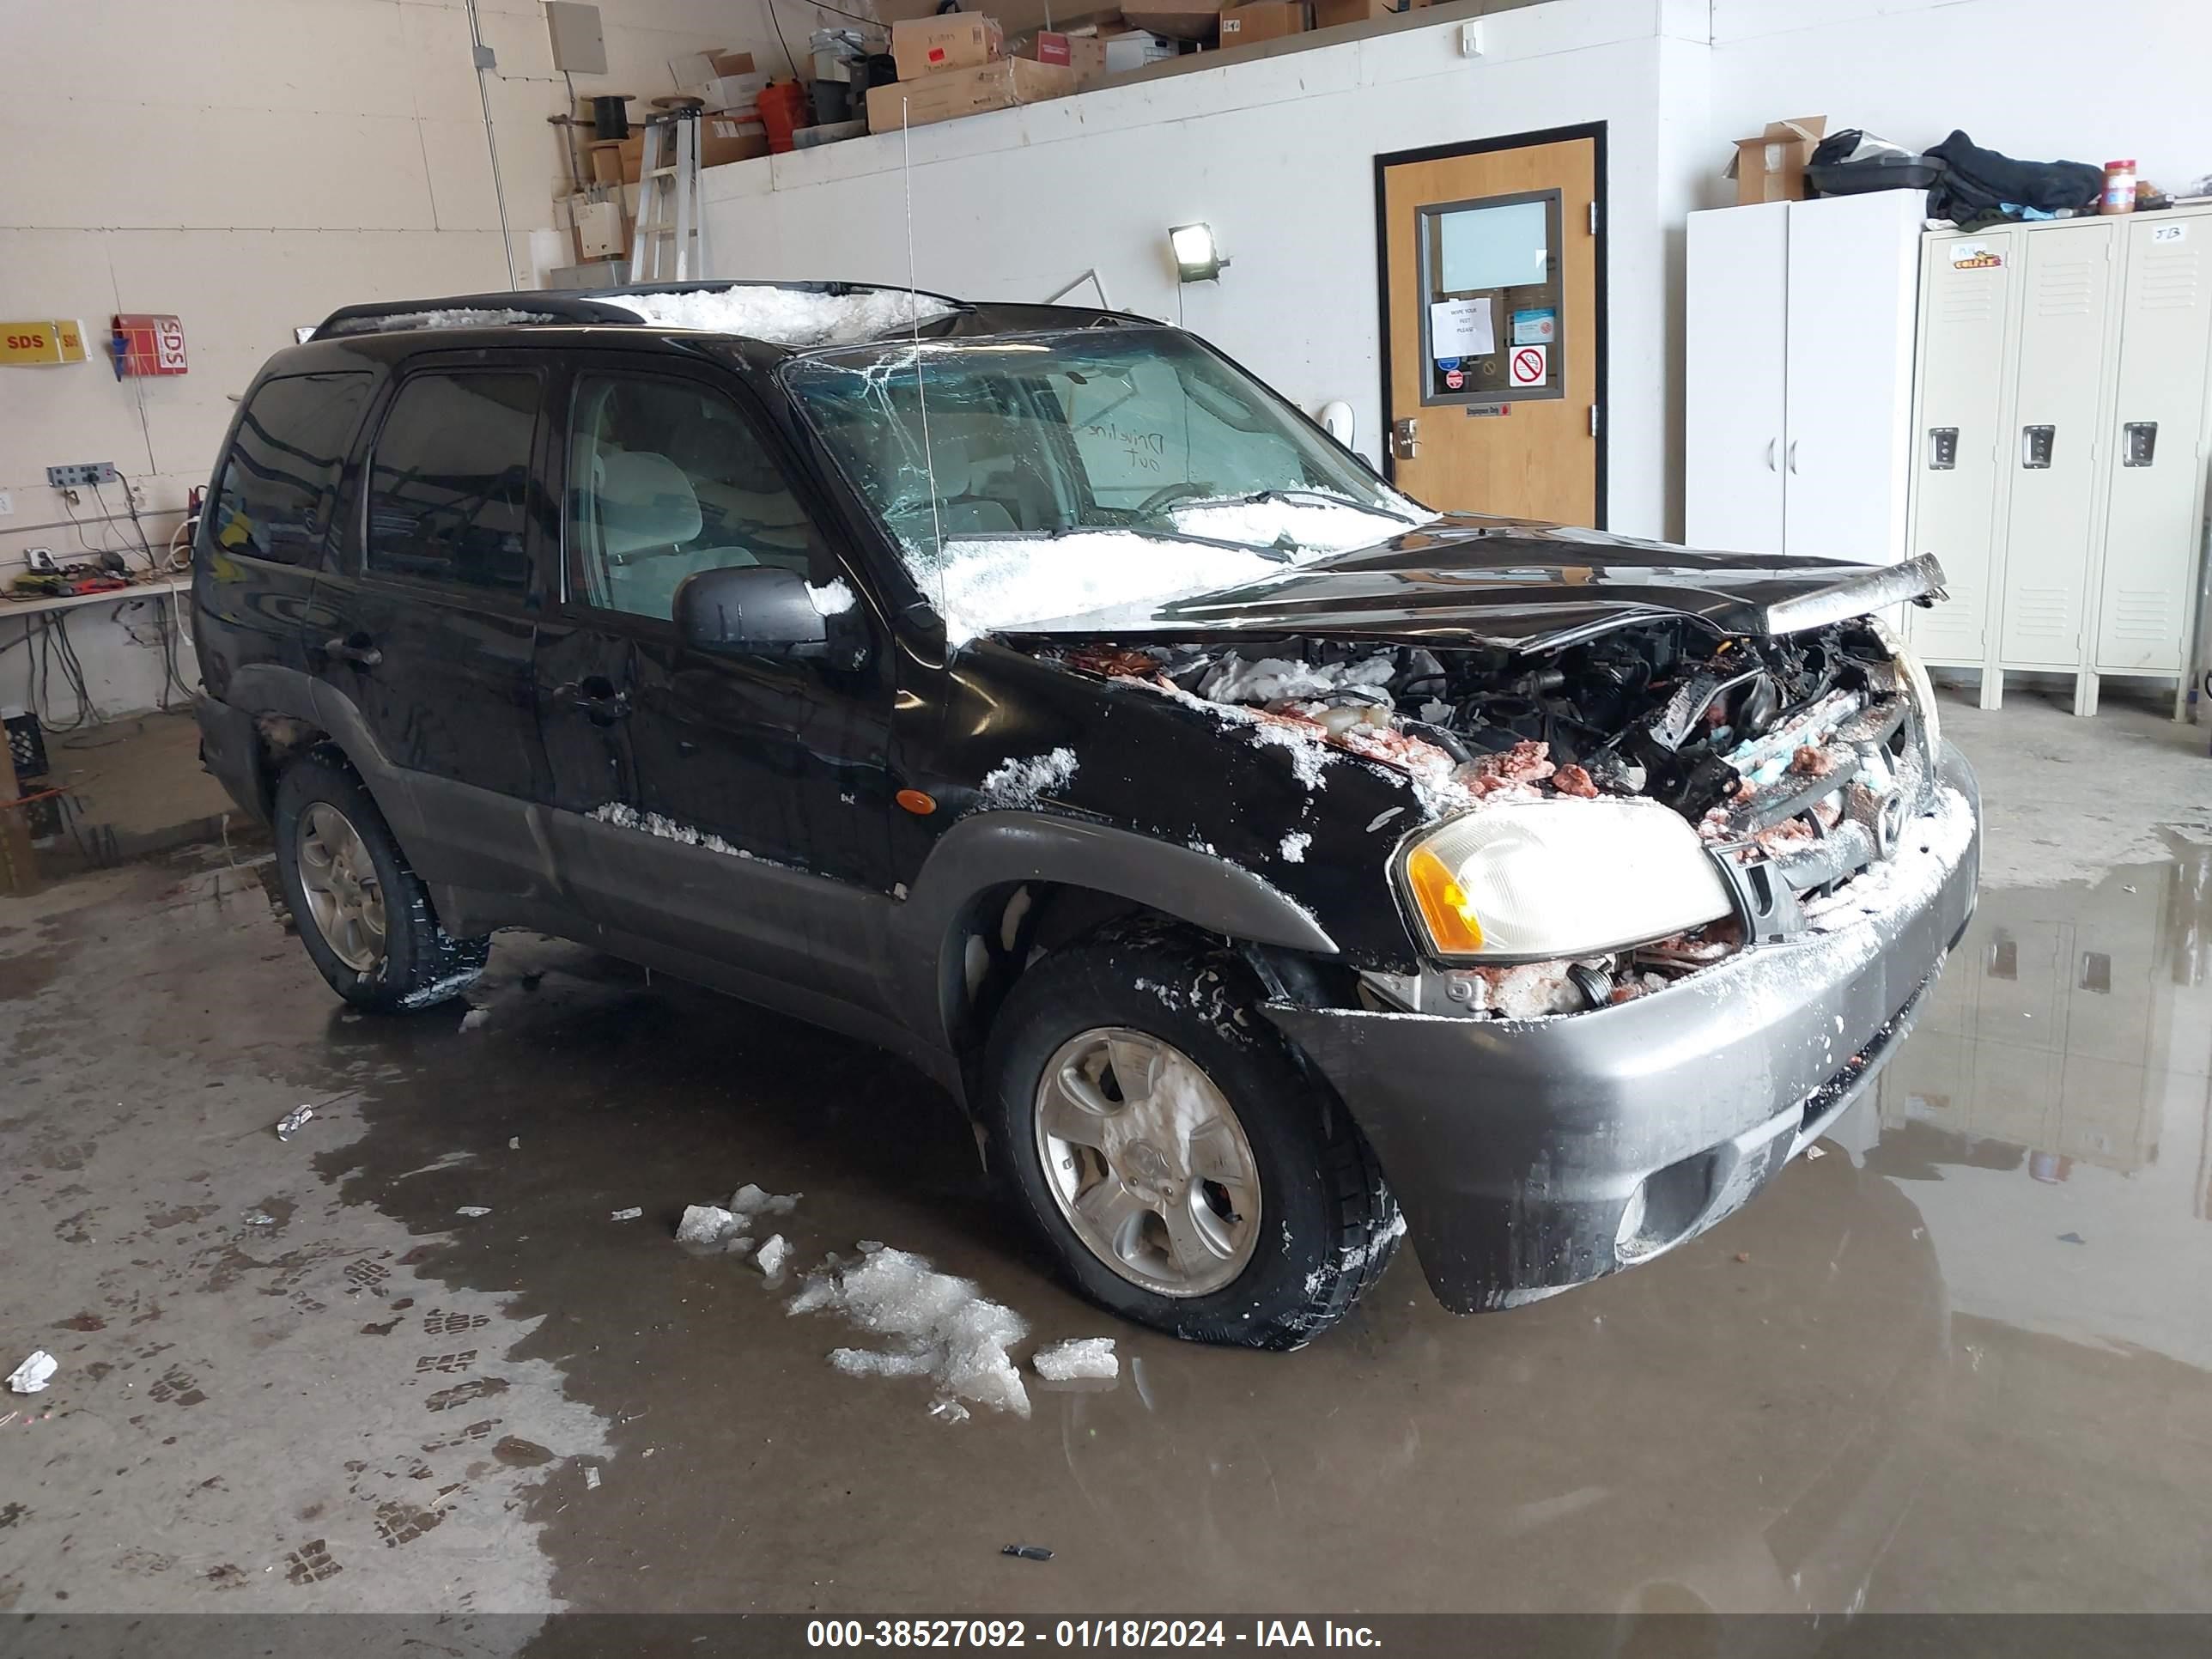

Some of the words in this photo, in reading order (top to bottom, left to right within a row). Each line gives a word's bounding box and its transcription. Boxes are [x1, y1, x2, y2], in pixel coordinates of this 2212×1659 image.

[7, 335, 45, 349] SDS
[63, 334, 78, 348] SDS
[161, 321, 184, 365] SDS
